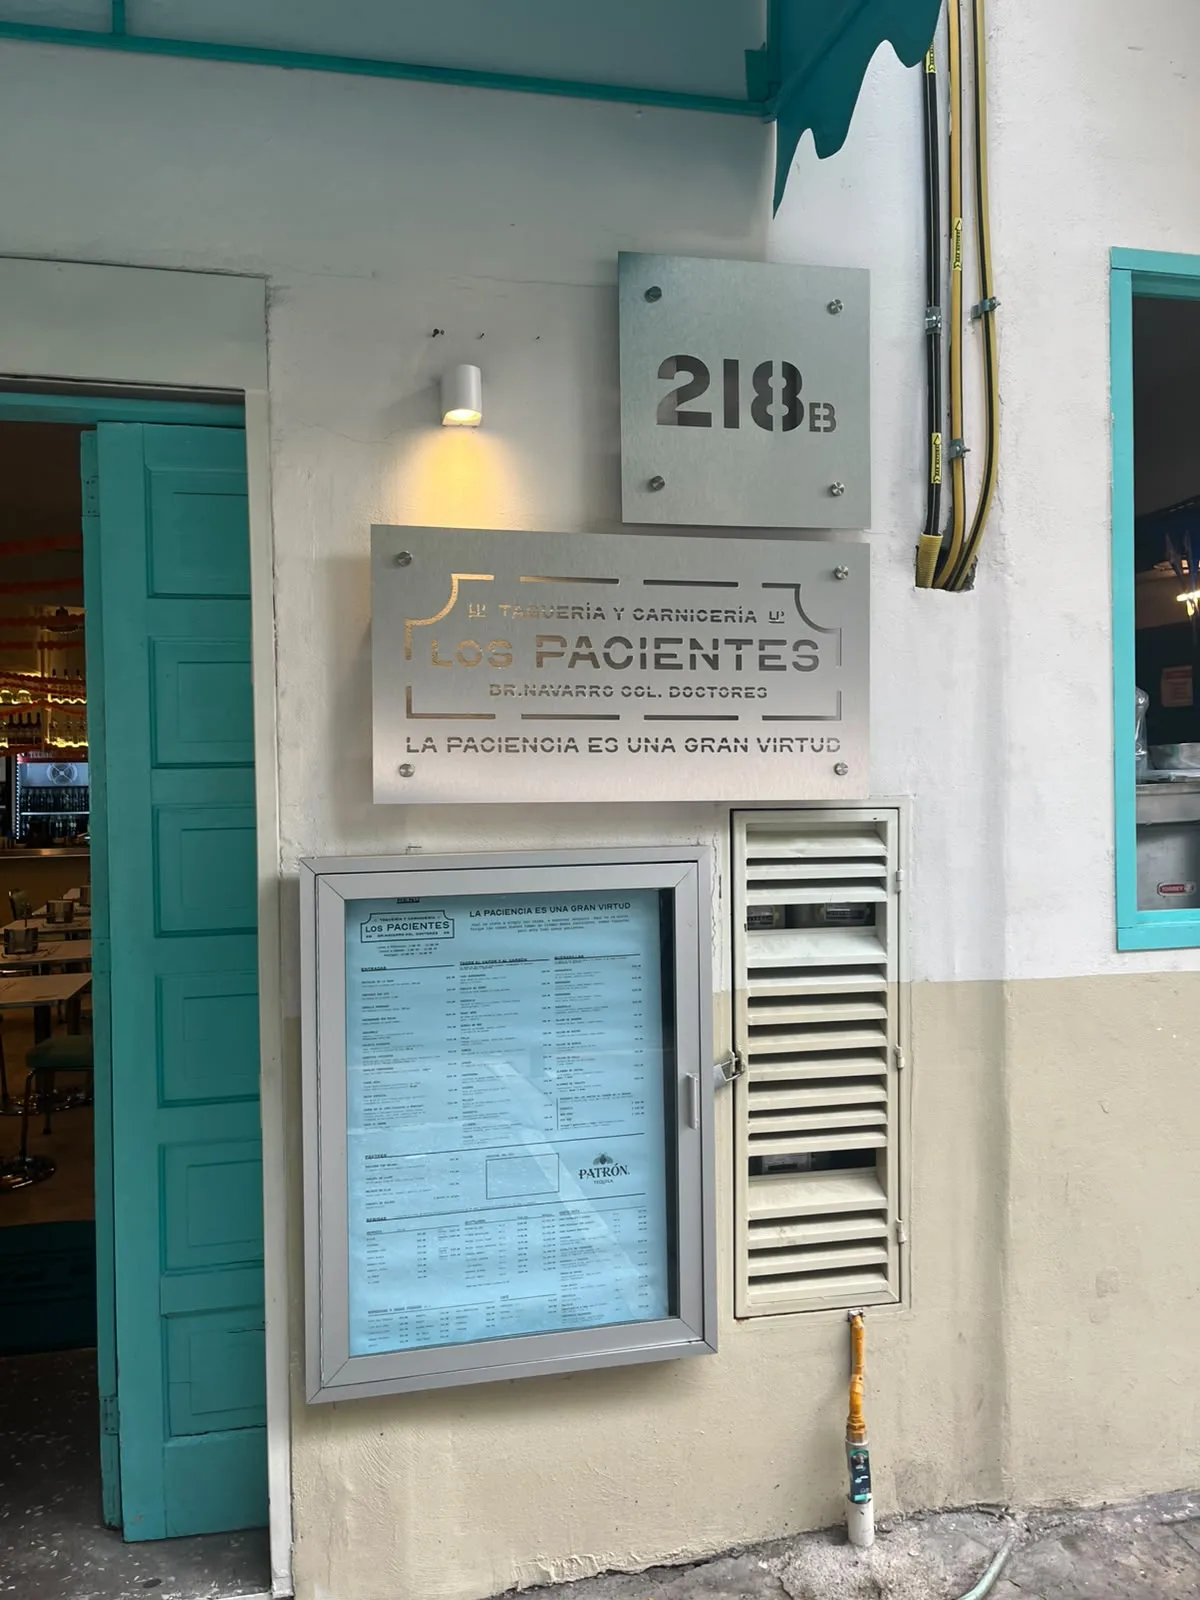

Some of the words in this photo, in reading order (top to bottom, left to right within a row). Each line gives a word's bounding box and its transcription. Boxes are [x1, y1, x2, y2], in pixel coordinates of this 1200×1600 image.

[499, 602, 606, 620] TAQUERÍA
[613, 607, 625, 621] Y
[632, 606, 758, 624] CARNICERÍA
[431, 639, 513, 668] LOS
[535, 634, 820, 673] PACIENTES
[669, 685, 768, 699] DOCTORES
[406, 736, 438, 753] LA
[446, 736, 580, 753] PACIENCIA
[587, 736, 619, 753] ES
[627, 736, 676, 753] UNA
[684, 736, 749, 753] GRAN
[756, 736, 841, 753] VIRTUD
[469, 909, 482, 918] LA
[484, 906, 533, 917] PACIENCIA
[535, 906, 547, 914] ES
[549, 905, 569, 914] UNA
[570, 903, 596, 912] GRAN
[599, 902, 631, 911] VIRTUD
[366, 925, 383, 933] LOS
[387, 921, 450, 932] PACIENTES
[578, 1163, 628, 1180] PATRÓN
